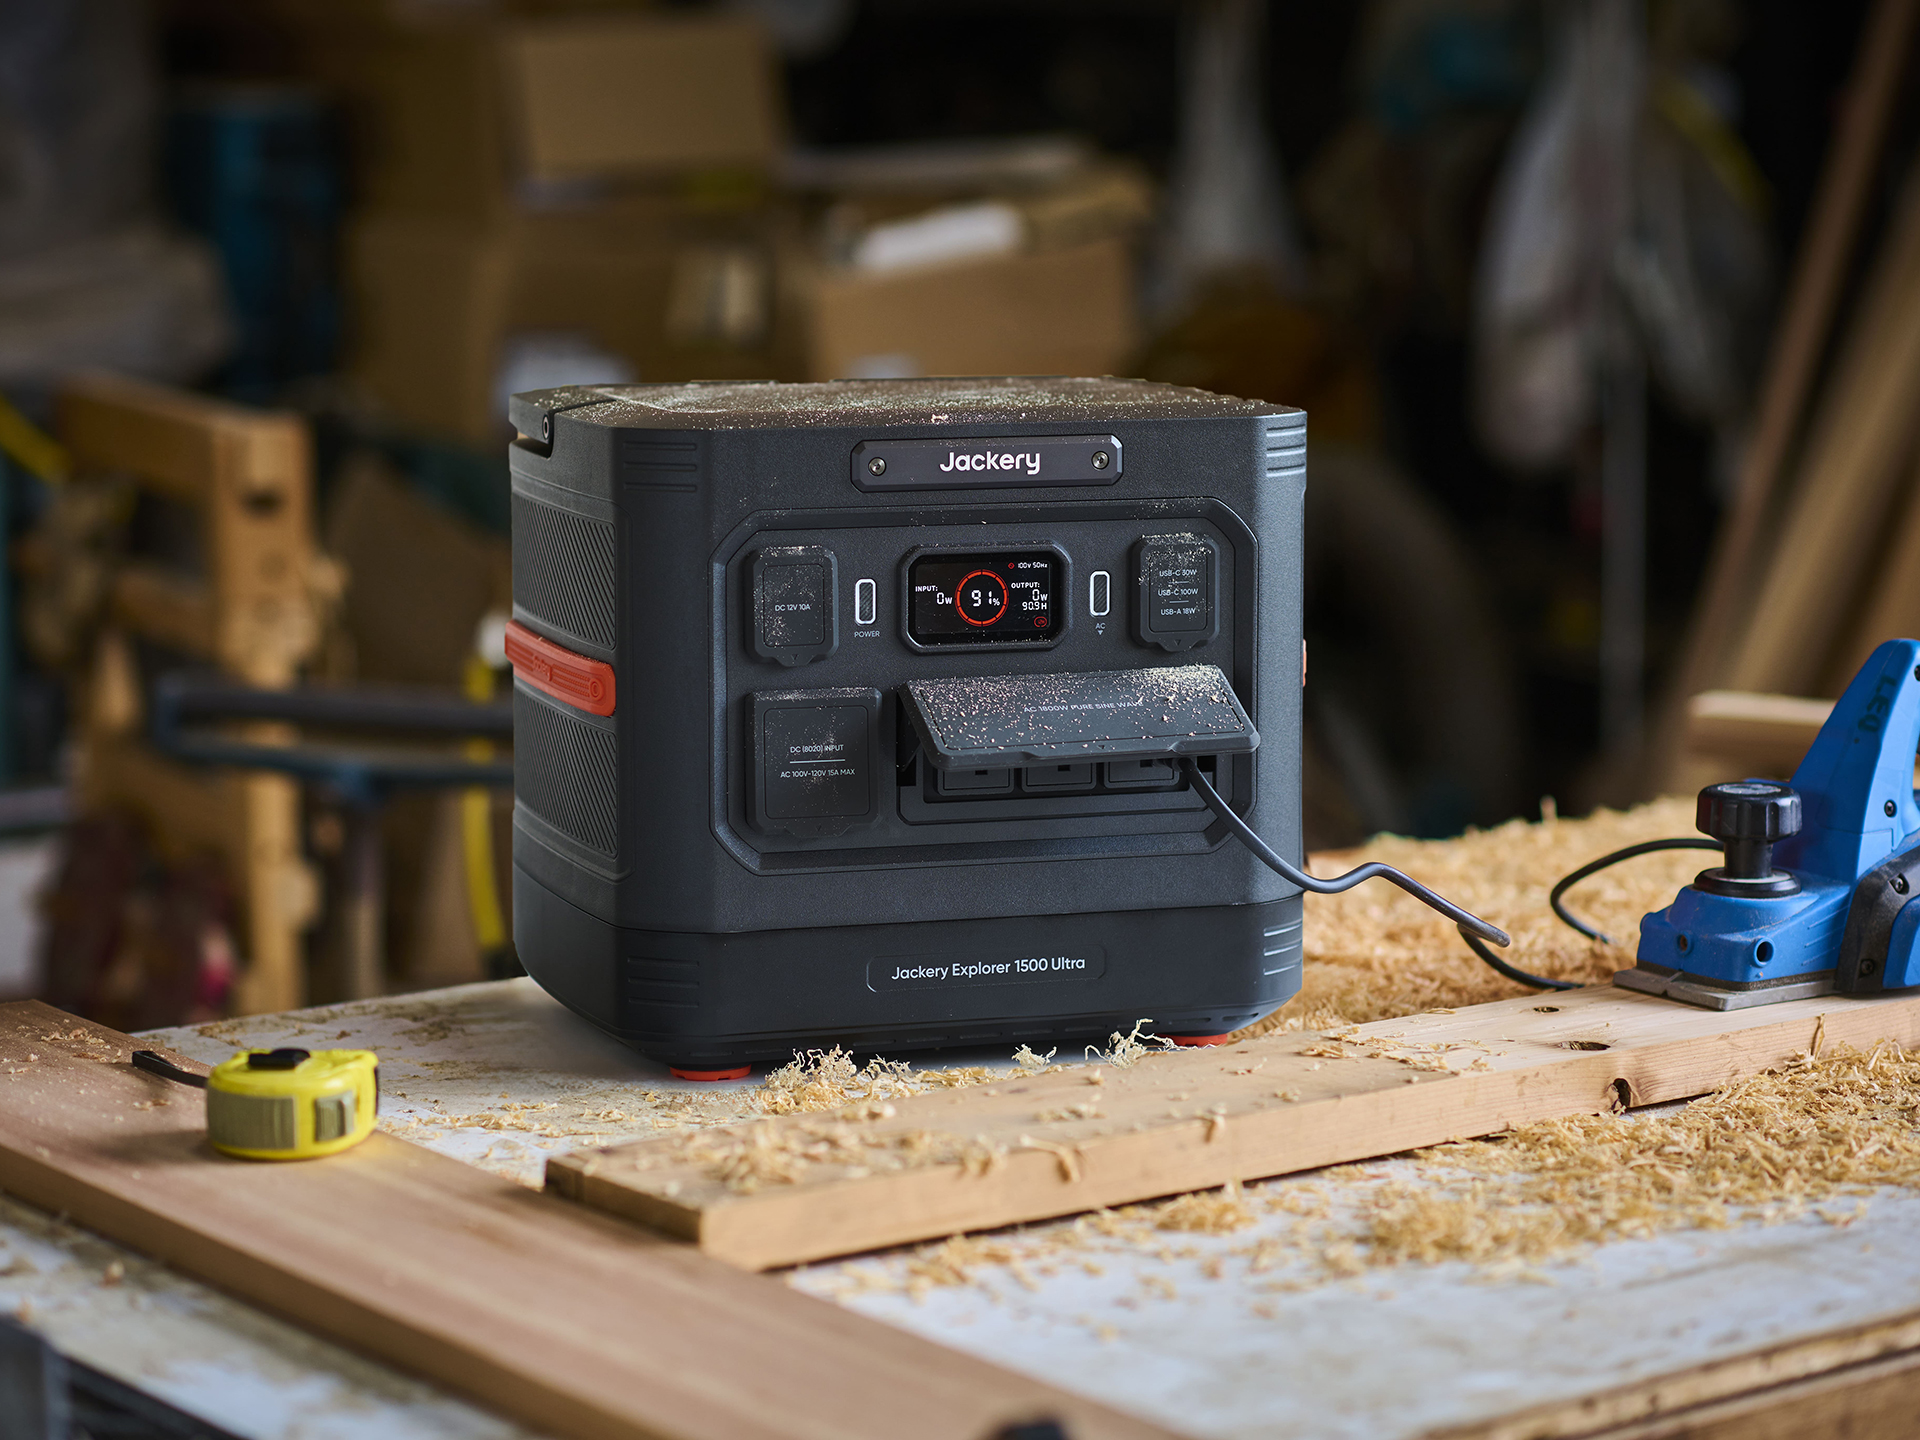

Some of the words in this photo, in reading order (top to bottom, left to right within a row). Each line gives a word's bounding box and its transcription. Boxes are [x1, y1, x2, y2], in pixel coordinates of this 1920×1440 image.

[939, 450, 1041, 475] Jackery
[1159, 570, 1181, 578] USB-C
[915, 585, 938, 593] INPUT:
[1158, 589, 1180, 597] USB-C
[1180, 588, 1199, 596] 100W
[774, 604, 786, 612] DC
[799, 603, 811, 611] 10A
[1160, 608, 1182, 616] USB-A
[1182, 607, 1196, 615] 18W
[1095, 622, 1106, 630] AC
[854, 630, 880, 638] POWER
[1039, 704, 1068, 713] 1800W
[1070, 703, 1094, 711] PURE
[1096, 702, 1115, 710] SINE
[1117, 699, 1144, 708] WAVE
[790, 745, 801, 754] DC
[824, 743, 844, 752] INPUT
[780, 771, 791, 779] AC
[828, 768, 839, 777] 15A
[840, 768, 856, 776] MAX
[891, 965, 949, 980] Jackery
[952, 961, 1011, 979] Explorer
[1014, 957, 1048, 973] 1500
[1051, 956, 1086, 971] Ultra
